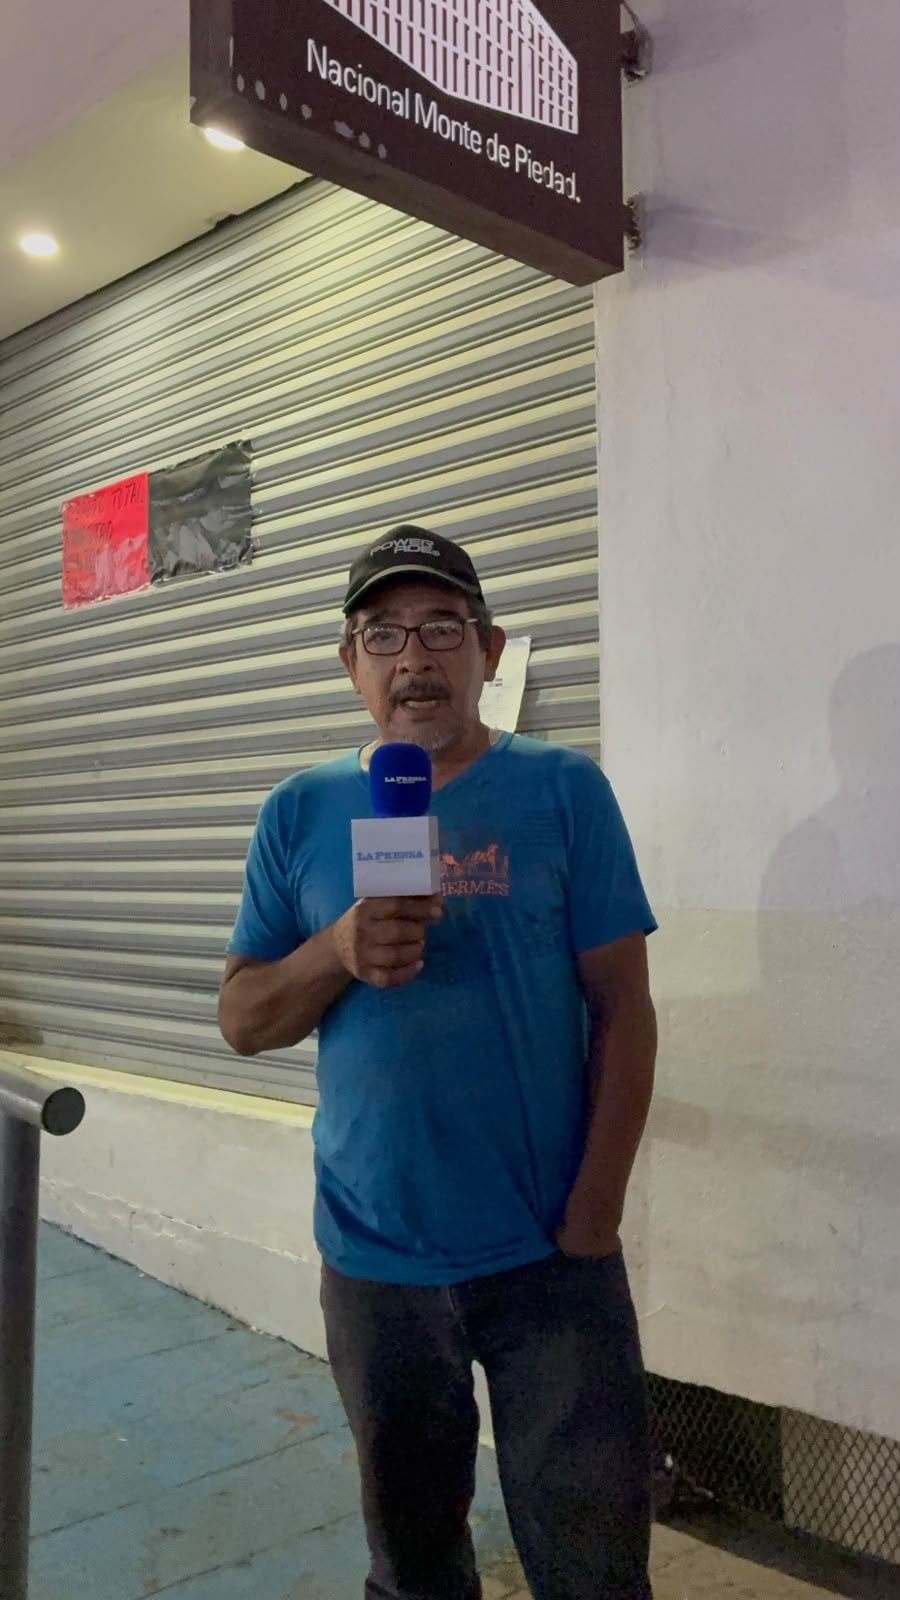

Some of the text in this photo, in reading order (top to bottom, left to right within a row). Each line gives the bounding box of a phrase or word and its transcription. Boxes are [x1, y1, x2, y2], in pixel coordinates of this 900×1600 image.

[306, 38, 582, 204] Nacional Monte de Piedad.
[357, 852, 373, 861] LA
[375, 850, 424, 860] PRENSA
